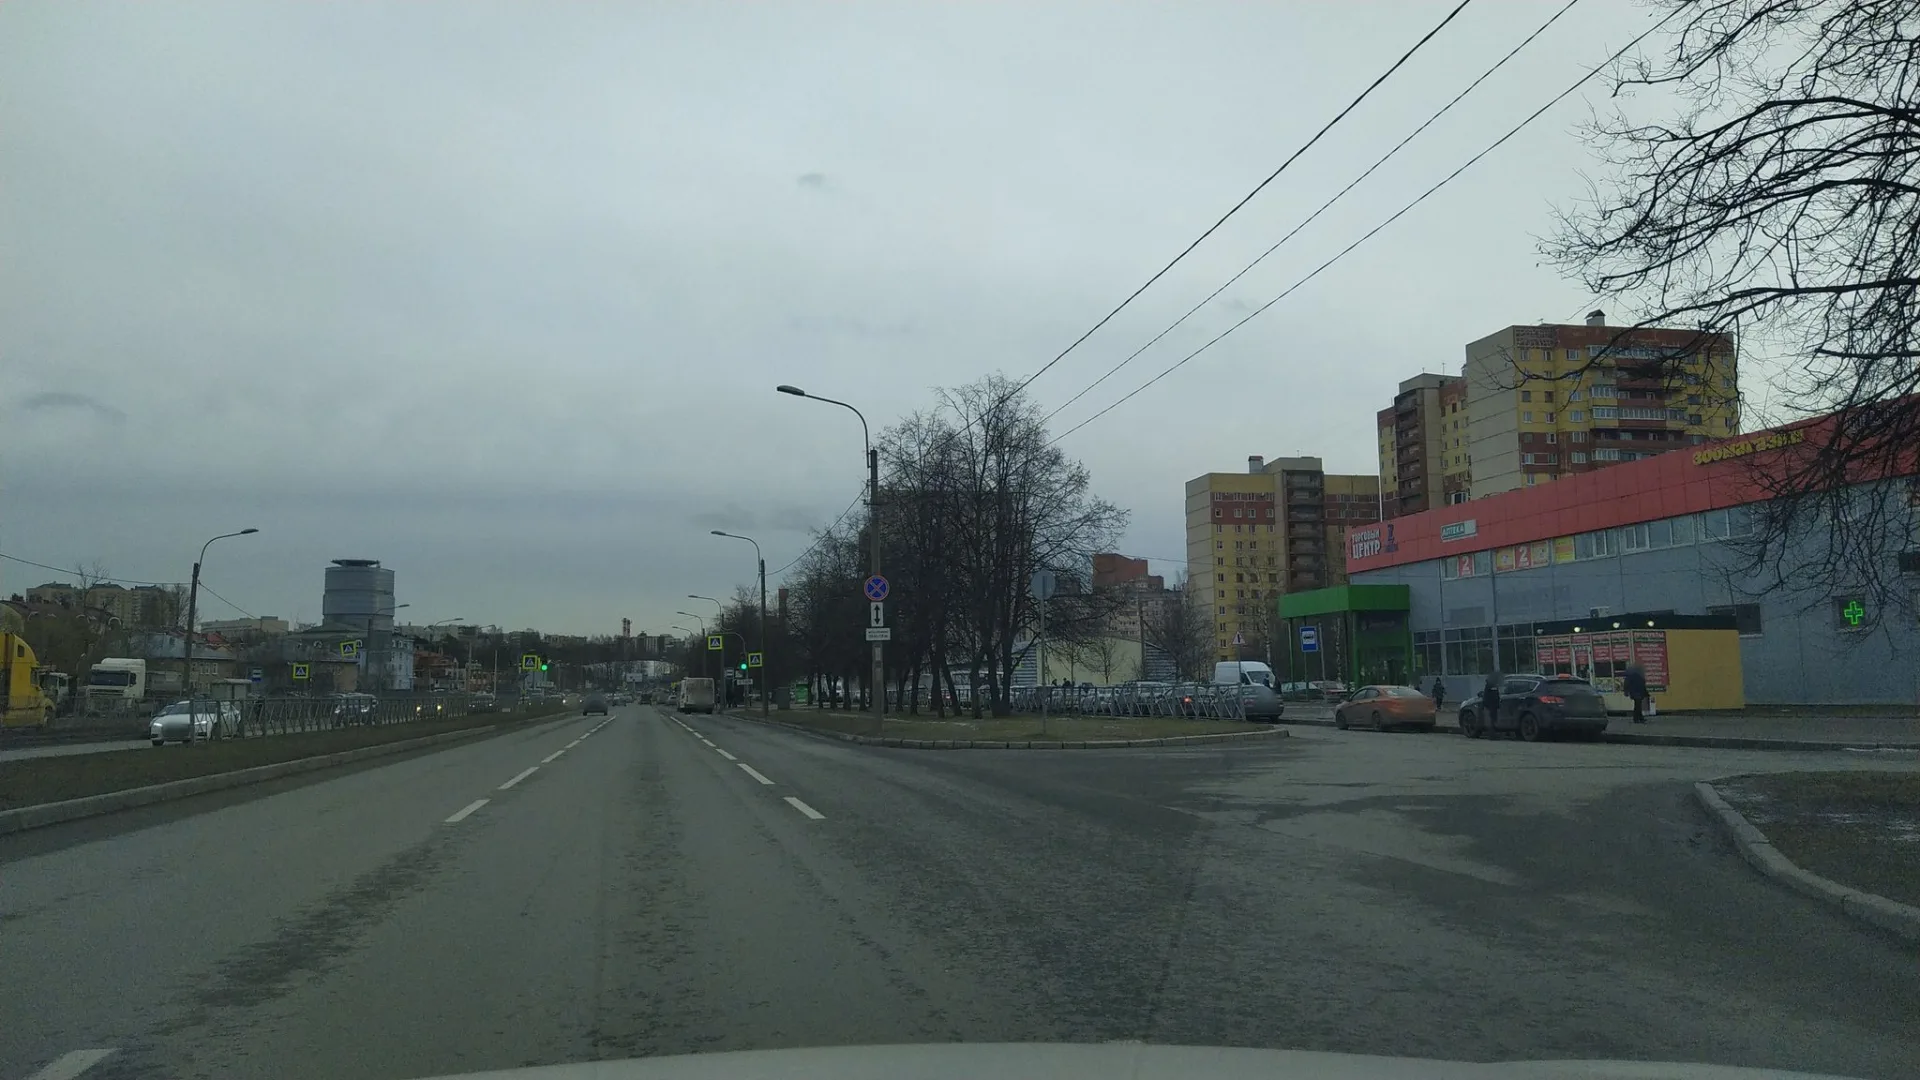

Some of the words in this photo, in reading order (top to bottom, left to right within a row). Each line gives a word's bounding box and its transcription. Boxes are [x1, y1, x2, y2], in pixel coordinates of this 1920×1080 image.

[1442, 525, 1464, 537] АПТЕКА
[1352, 541, 1381, 559] ЦЕНТР
[1520, 545, 1529, 561] 2
[1461, 556, 1470, 572] 2
